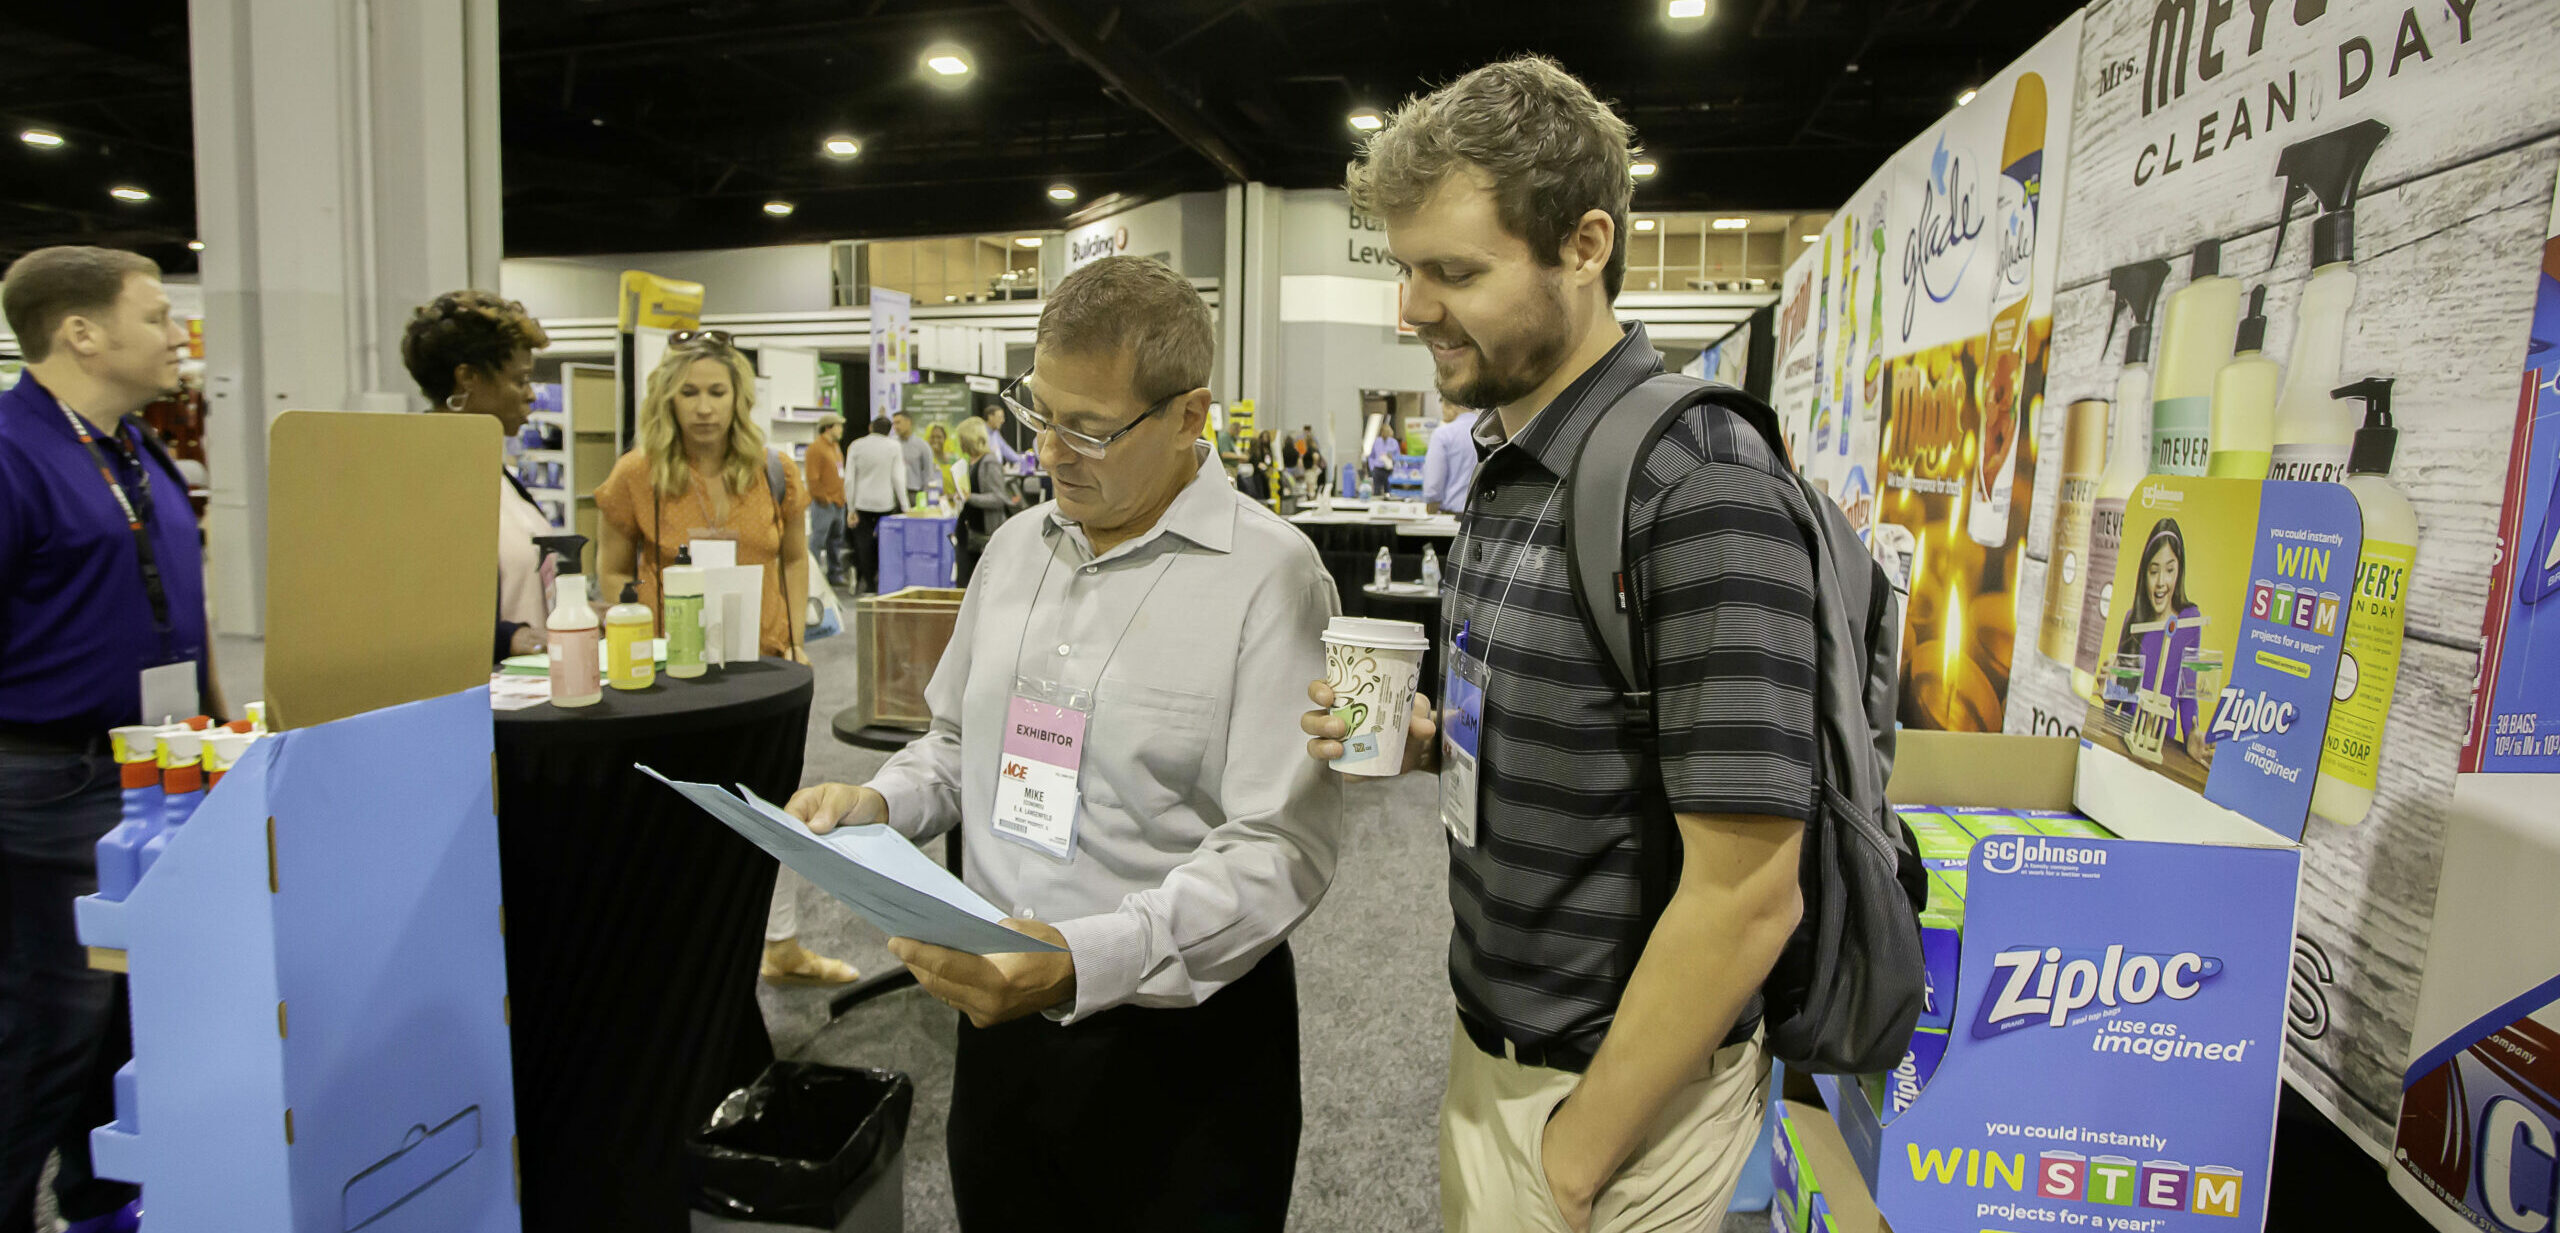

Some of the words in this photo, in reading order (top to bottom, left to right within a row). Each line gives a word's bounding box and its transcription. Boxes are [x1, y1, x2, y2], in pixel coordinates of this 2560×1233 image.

[2098, 56, 2139, 98] Mrs.
[2142, 0, 2328, 118] MEY
[2134, 70, 2296, 187] CLEAN
[2339, 0, 2477, 100] DAY
[2271, 528, 2285, 539] you
[2285, 529, 2307, 541] could
[2307, 529, 2343, 548] instantly
[2277, 543, 2331, 583] WIN
[2253, 589, 2336, 633] STEM
[2371, 603, 2395, 619] DAY
[2251, 629, 2282, 645] projects
[2283, 634, 2294, 648] for
[2212, 687, 2294, 742] Ziploc
[2495, 714, 2510, 735] 38
[2509, 713, 2538, 735] BAGS
[1016, 723, 1074, 748] EXHIBITOR
[2252, 742, 2266, 755] use
[2266, 748, 2277, 759] as
[2342, 738, 2371, 761] SOAP
[1003, 760, 1028, 780] ACE
[2244, 747, 2299, 783] imagined
[1025, 786, 1045, 803] MIKE
[1988, 944, 2202, 1028] Ziploc
[2000, 1018, 2025, 1031] BRAND
[2107, 1019, 2147, 1035] use
[2150, 1021, 2177, 1037] as
[2092, 1028, 2247, 1062] imagined
[1986, 1121, 2021, 1138] you
[2024, 1124, 2077, 1142] could
[2081, 1127, 2167, 1152] instantly
[1907, 1142, 2026, 1192] WIN
[2045, 1162, 2238, 1214] STEM
[1976, 1202, 2056, 1224] projects
[2059, 1208, 2088, 1226] for
[2091, 1215, 2104, 1227] a
